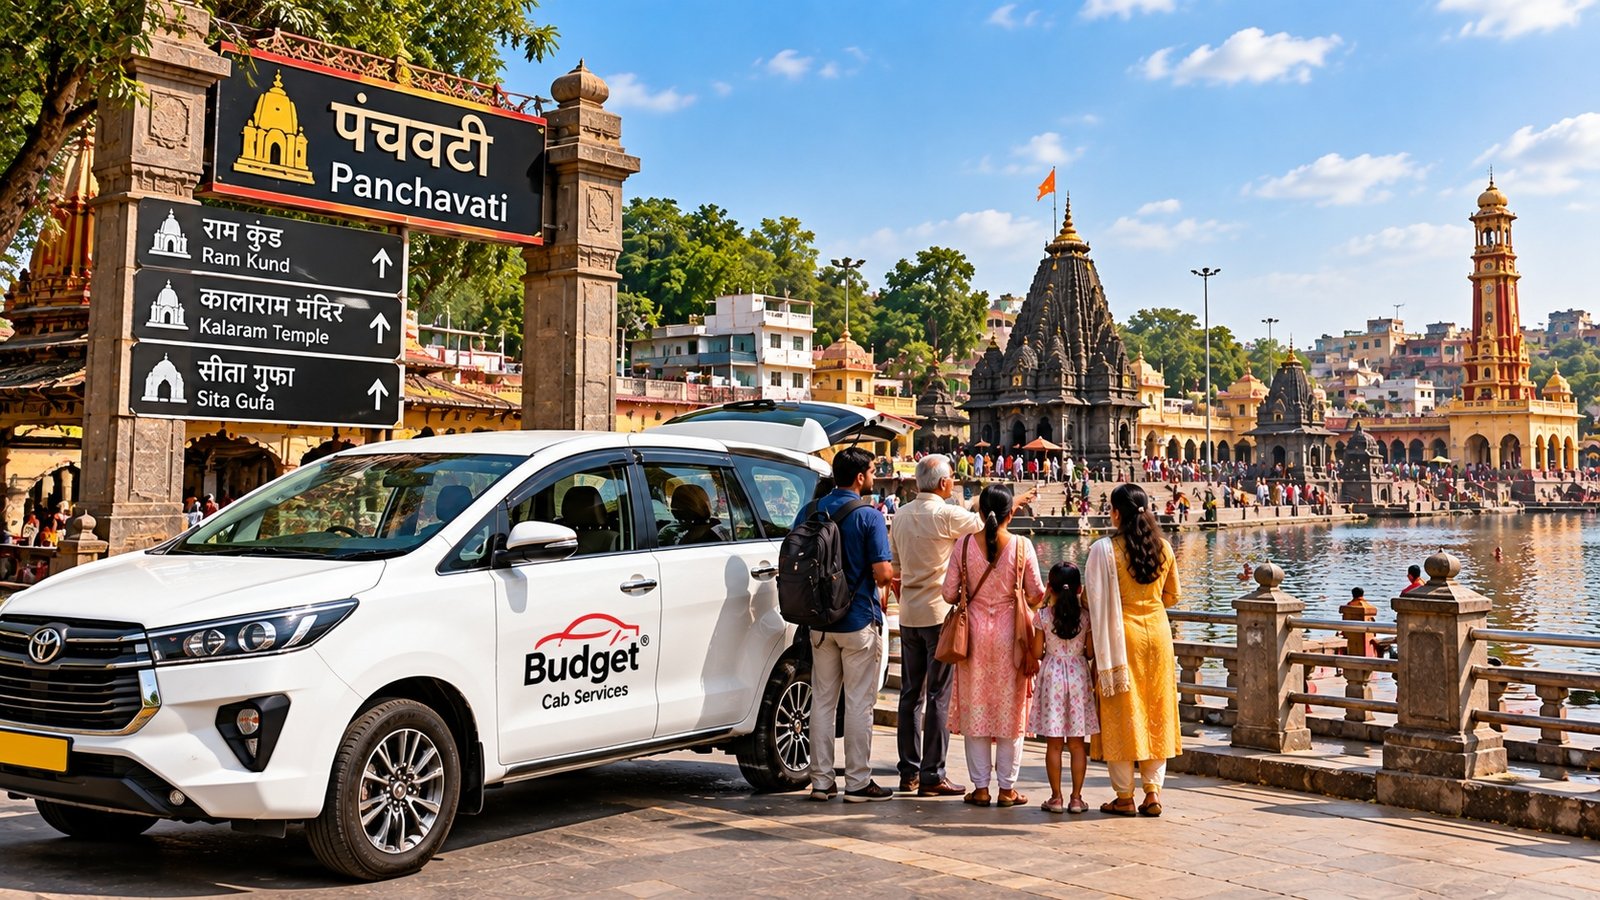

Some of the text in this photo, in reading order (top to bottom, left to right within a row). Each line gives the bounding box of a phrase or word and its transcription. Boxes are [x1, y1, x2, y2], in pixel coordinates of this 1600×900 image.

[331, 92, 494, 177] पंचवटी
[332, 162, 508, 223] Panchavati
[203, 218, 283, 251] राम कुंड
[202, 247, 290, 274] Ram Kund
[200, 288, 346, 323] कालाराम मंदिर
[199, 317, 330, 347] Kalaram Temple
[198, 354, 295, 393] सीता गुफा
[197, 390, 275, 411] Sita Gufa
[542, 685, 629, 710] Cab Services
